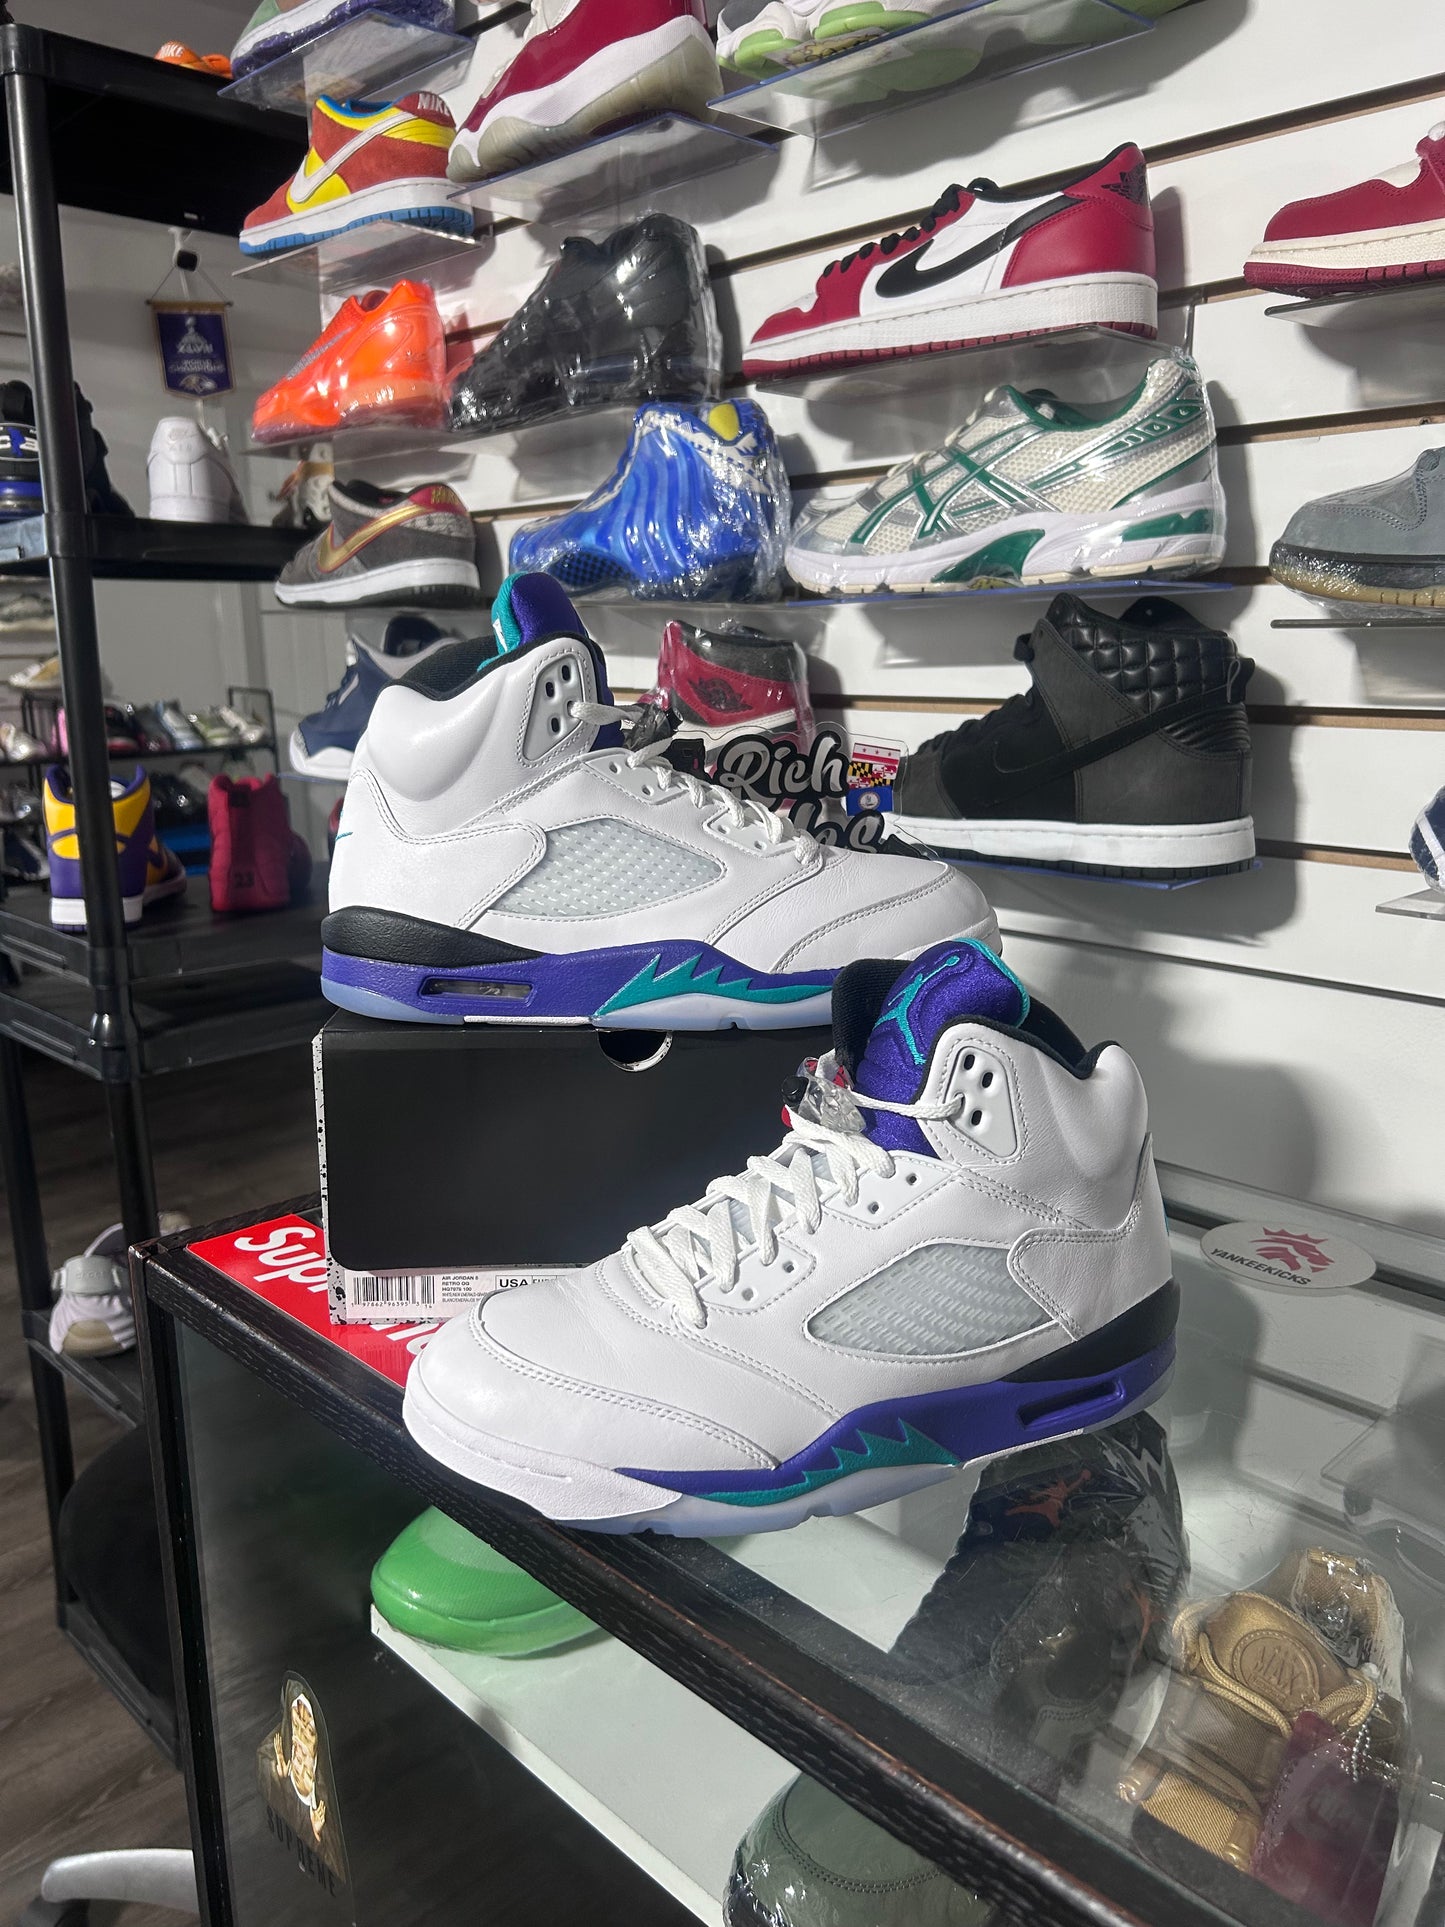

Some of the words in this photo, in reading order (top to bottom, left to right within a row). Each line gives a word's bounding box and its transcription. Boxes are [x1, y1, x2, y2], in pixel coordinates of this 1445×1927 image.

[417, 93, 450, 117] NIKE
[719, 736, 843, 806] Rich
[1210, 1248, 1311, 1285] YANKEEKICKS
[499, 1278, 528, 1288] USA
